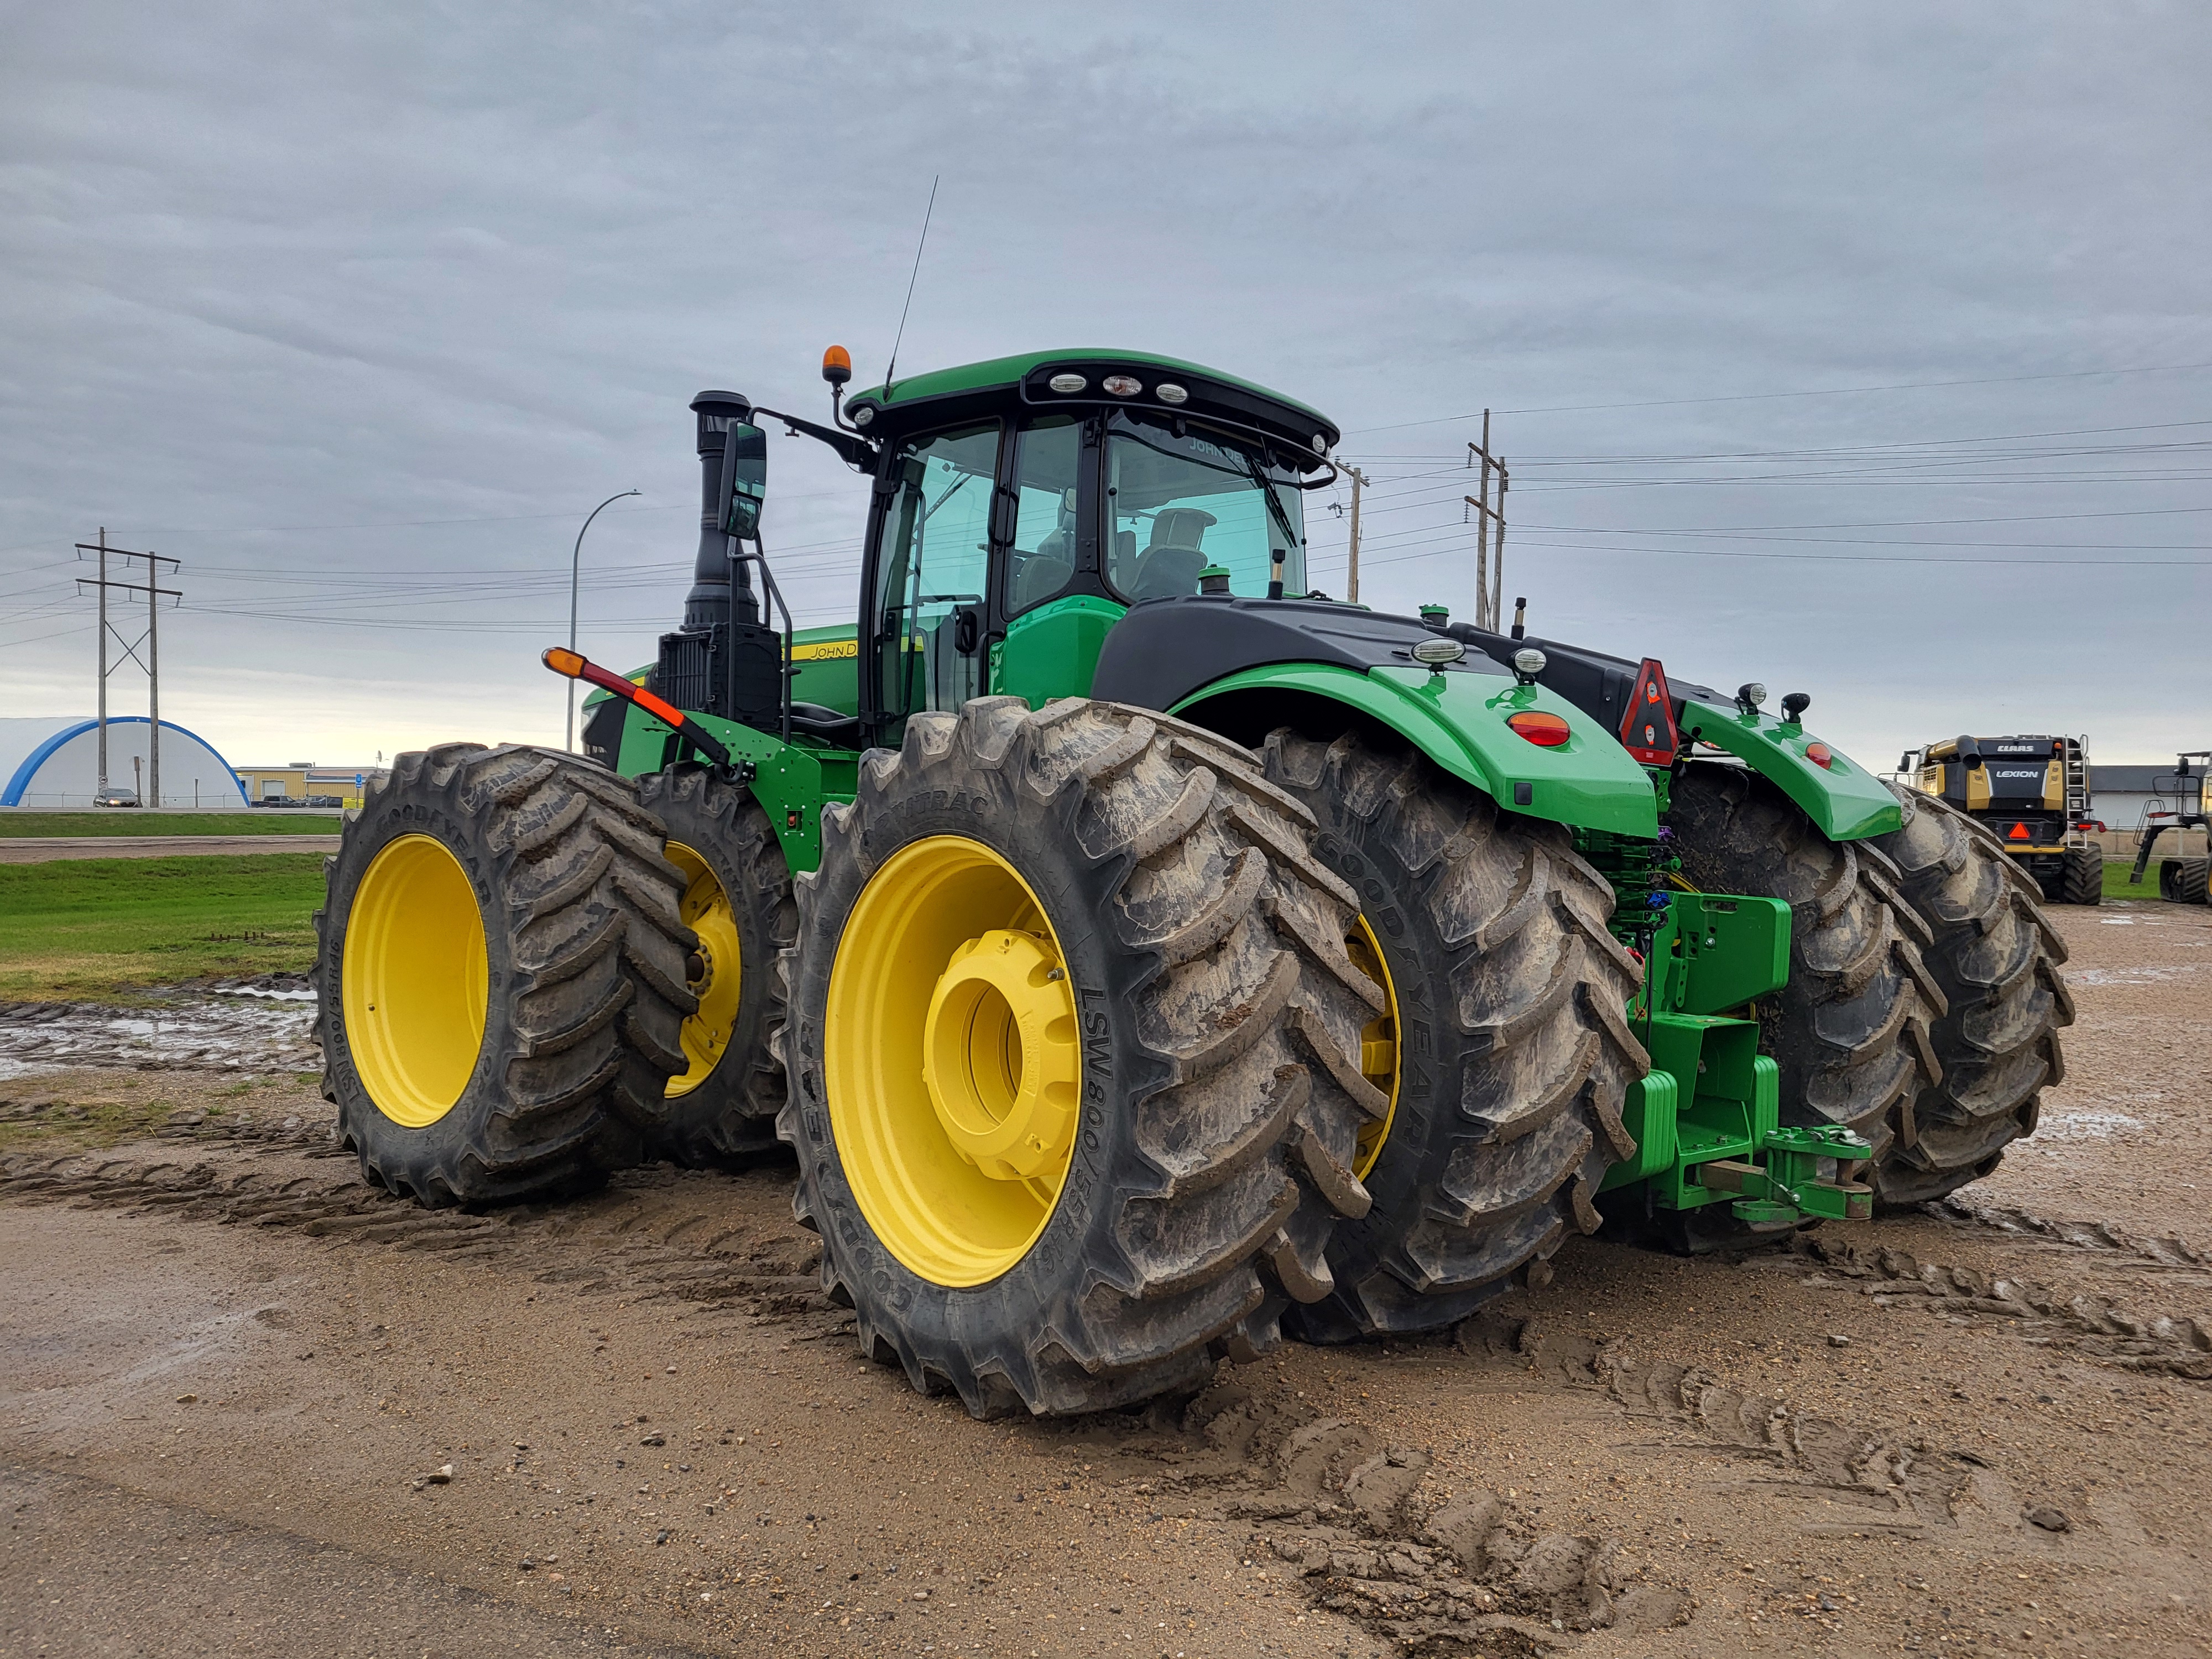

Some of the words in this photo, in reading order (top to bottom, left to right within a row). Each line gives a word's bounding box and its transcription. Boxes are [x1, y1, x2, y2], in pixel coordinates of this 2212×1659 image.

[1189, 437, 1223, 458] JOHN
[1223, 447, 1261, 465] DEE
[810, 646, 844, 659] JOHN
[847, 644, 857, 655] D
[328, 938, 346, 1057] 800/55R46
[1080, 987, 1113, 1079] LSW
[1316, 832, 1432, 1158] GOODYEAR
[336, 1059, 362, 1105] LSW
[1041, 1081, 1107, 1274] 800/55R46
